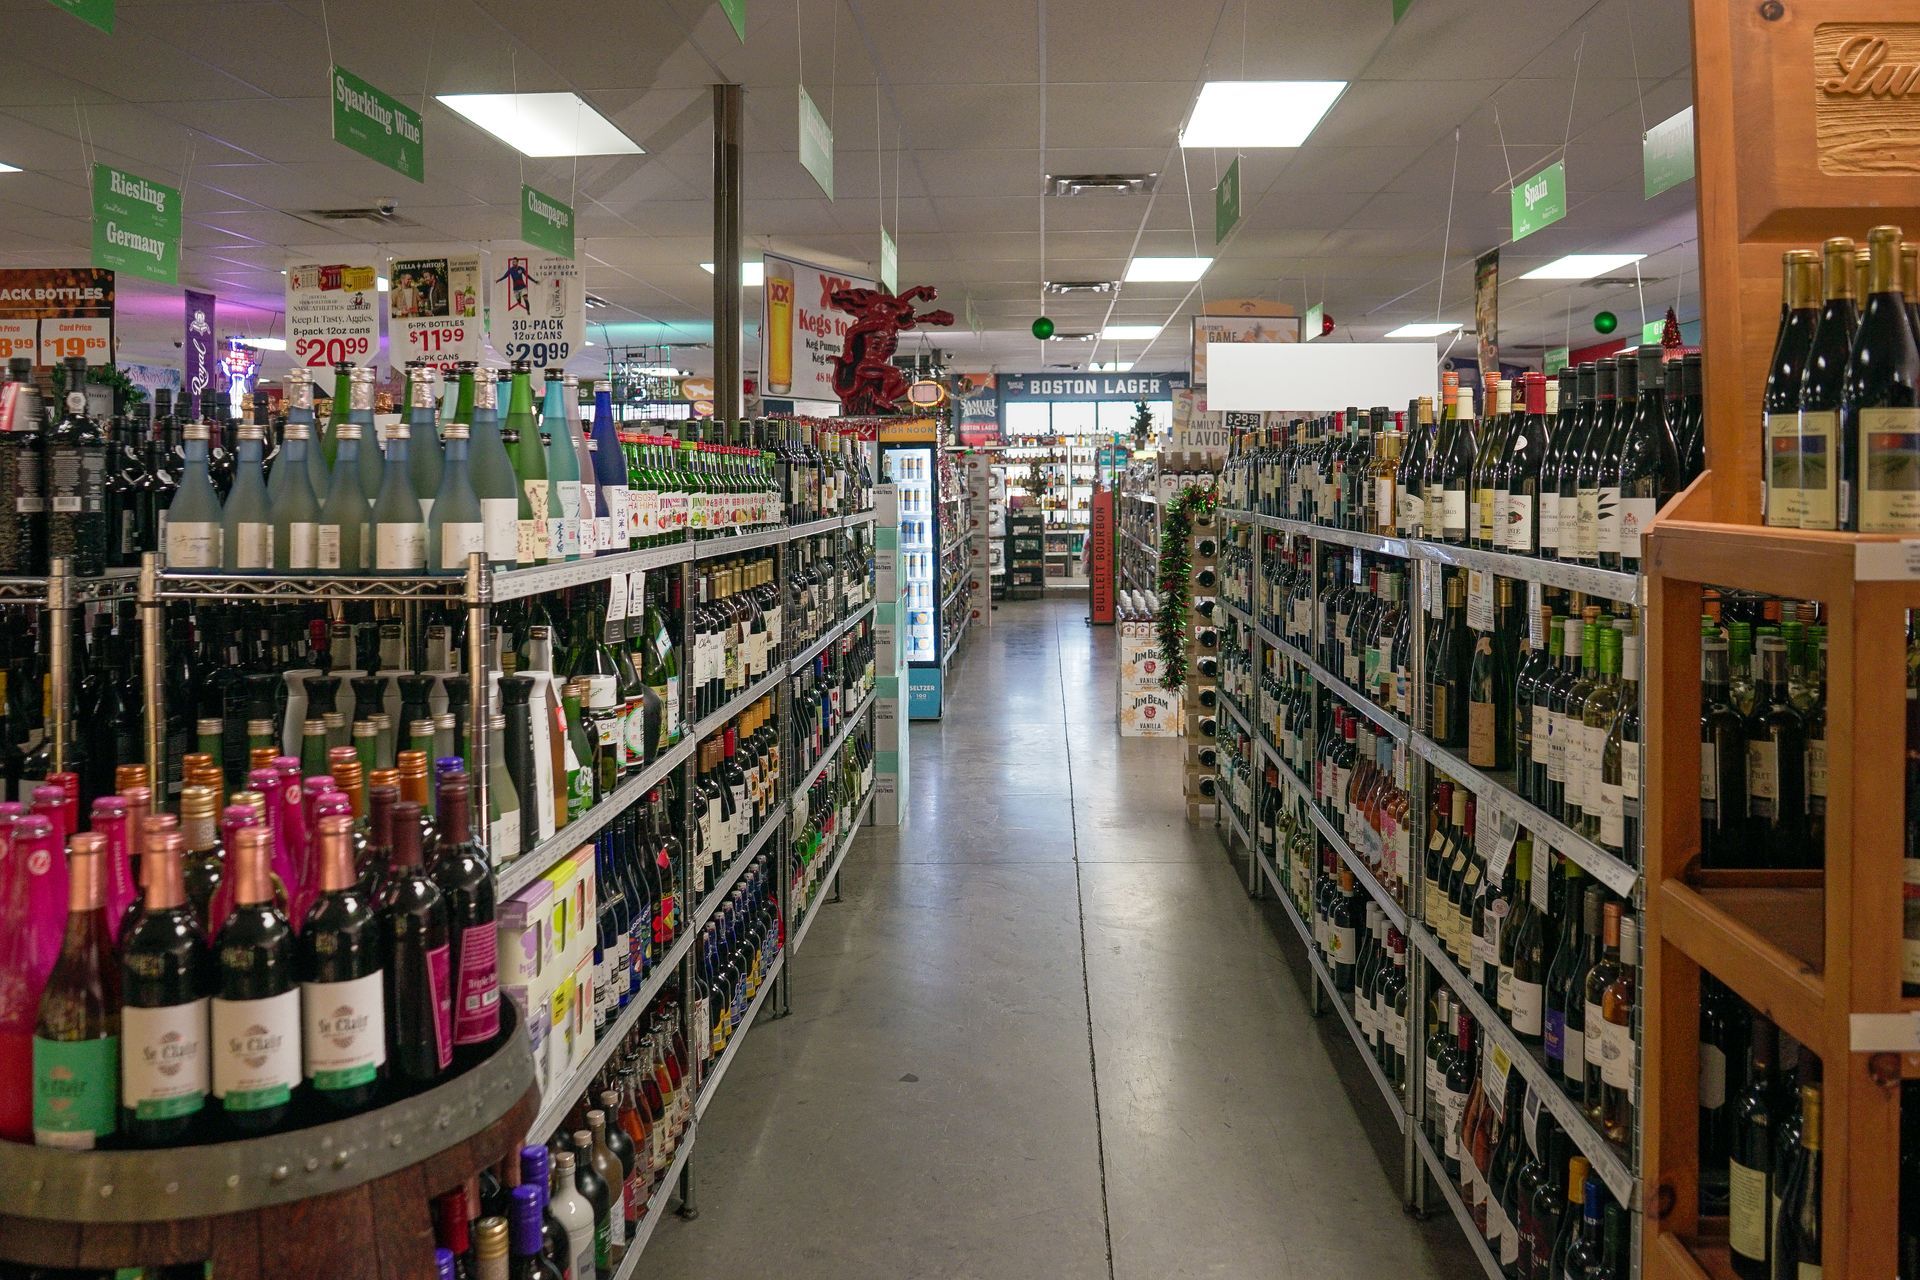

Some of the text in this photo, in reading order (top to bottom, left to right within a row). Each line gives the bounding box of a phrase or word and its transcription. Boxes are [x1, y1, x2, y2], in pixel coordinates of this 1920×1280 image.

[336, 75, 420, 144] Sparkling Wine
[110, 170, 166, 212] Riesling
[1525, 176, 1548, 211] Spain
[528, 190, 569, 229] Champagne
[107, 221, 165, 261] Germany
[35, 288, 103, 300] BOTTLES
[291, 315, 312, 325] Keep
[313, 315, 320, 323] It
[429, 320, 465, 328] BOTTLES
[512, 320, 564, 330] 30-PACK
[799, 308, 832, 338] Kegs
[58, 324, 92, 332] Card Price
[293, 327, 324, 337] 8-pack
[326, 327, 347, 335] 12oz
[514, 331, 562, 340] 12oz CANS
[1209, 331, 1237, 343] GAME
[806, 338, 841, 353] Keg Pumps
[812, 352, 825, 365] Keg
[191, 338, 210, 396] Royal
[1030, 380, 1097, 394] BOSTON
[1104, 379, 1160, 394] LAGER
[960, 398, 998, 410] SAMUEL
[962, 408, 996, 417] ADAMS
[1096, 506, 1105, 612] BULLEIT BOURBON
[1133, 652, 1147, 665] JIM
[1133, 695, 1168, 710] JIM BEAM
